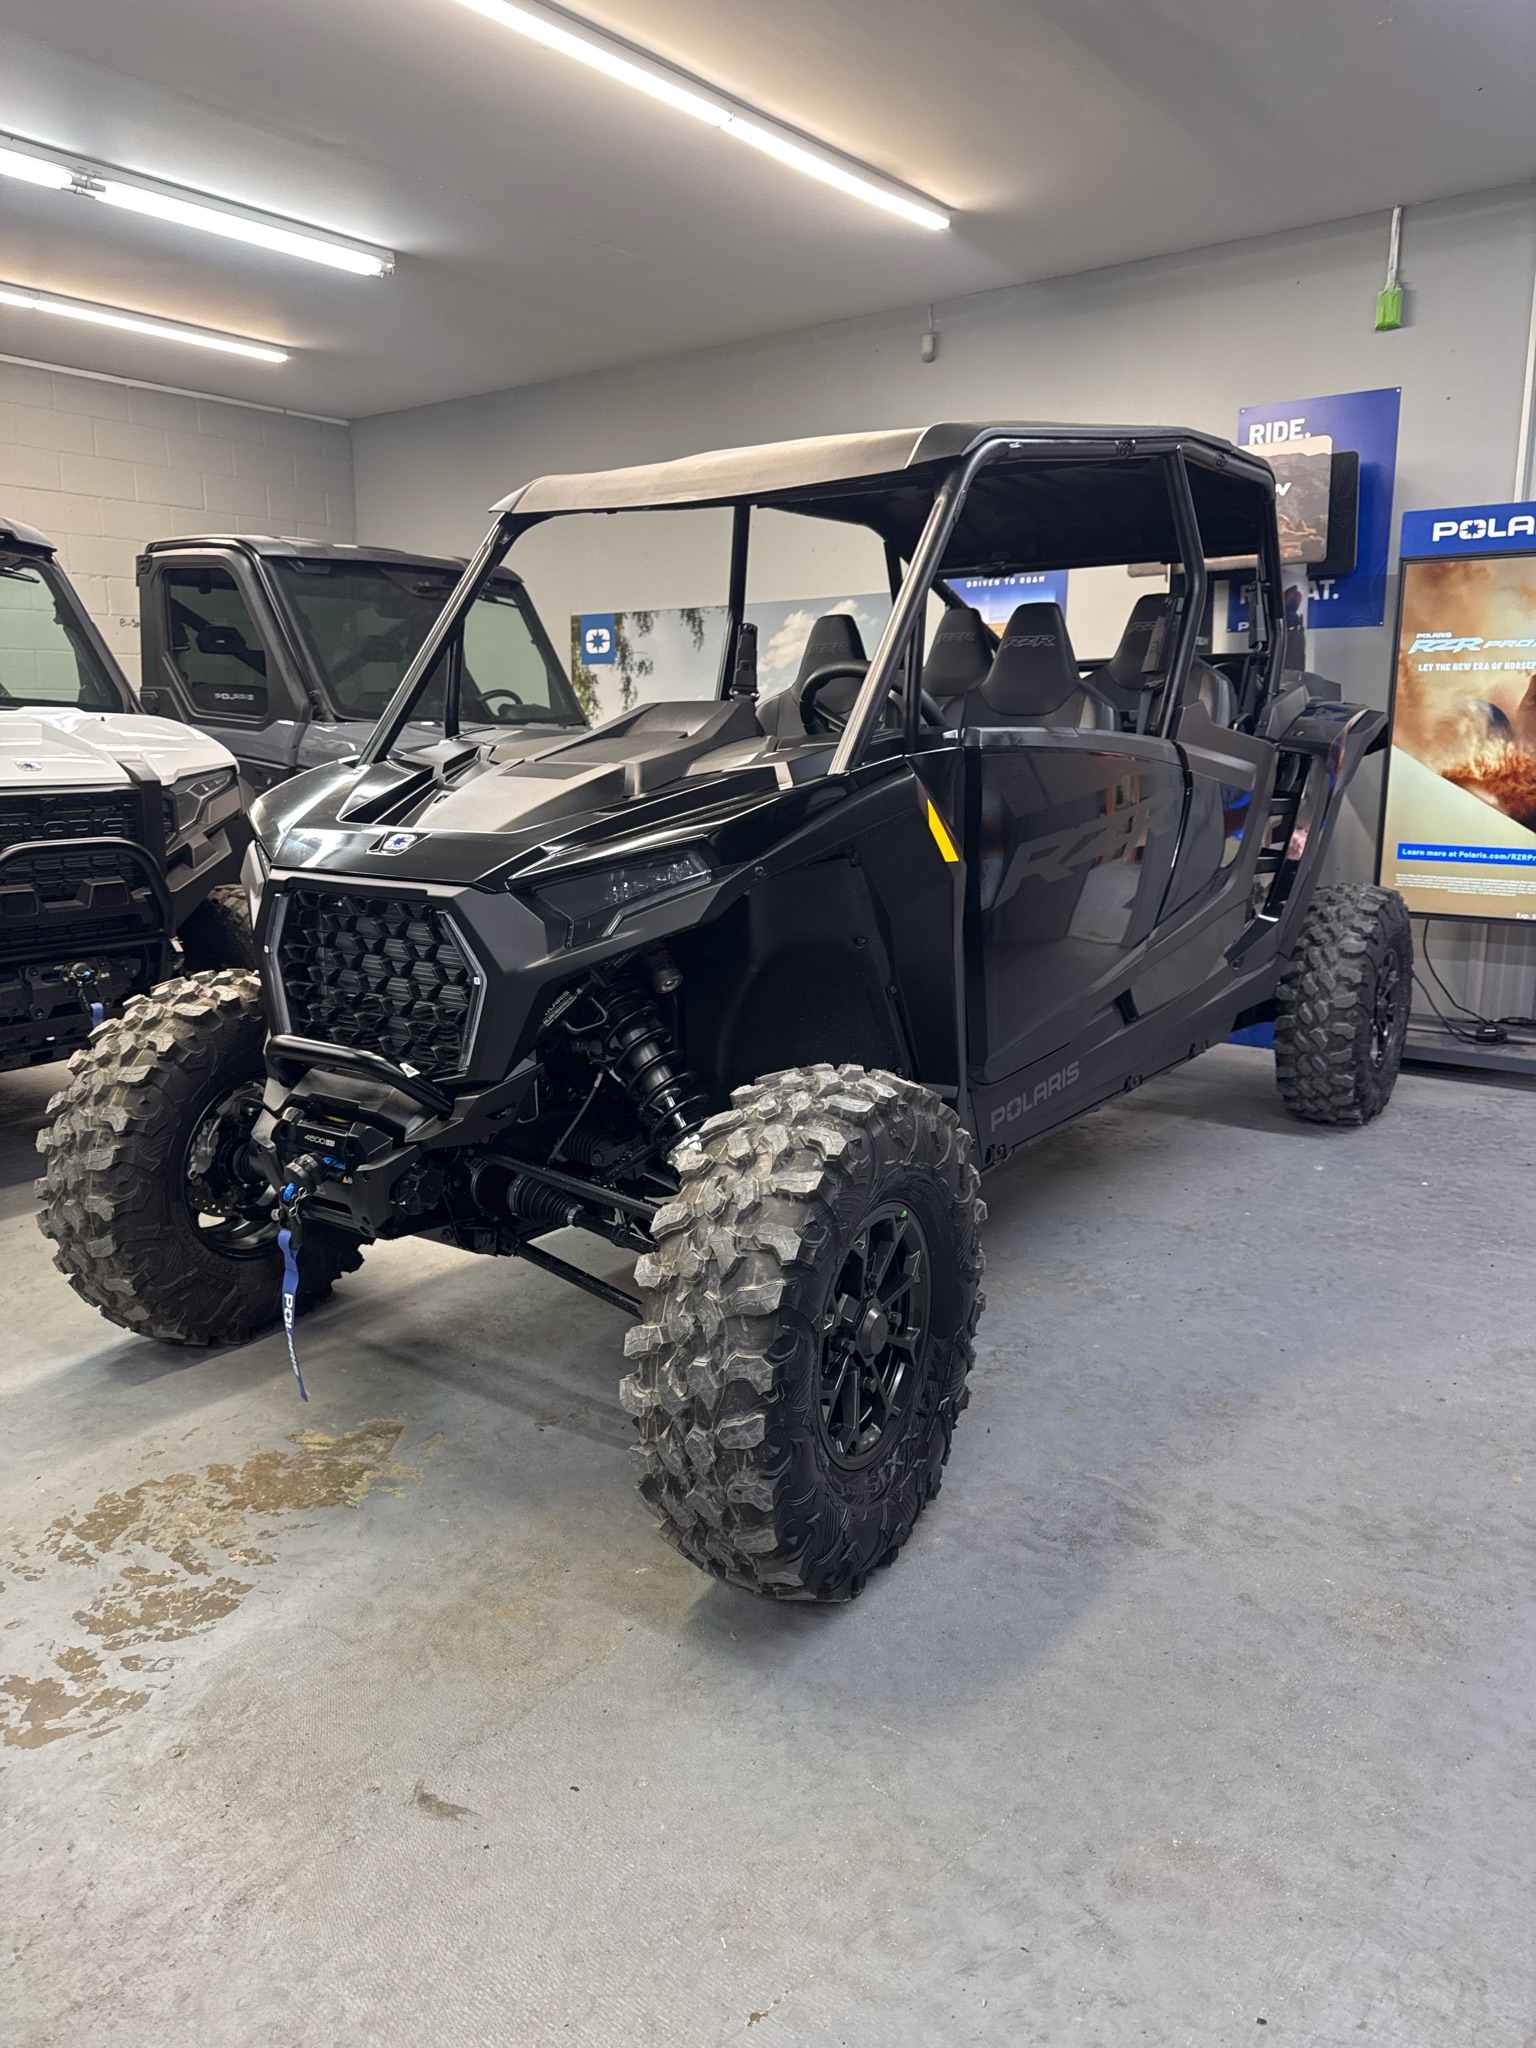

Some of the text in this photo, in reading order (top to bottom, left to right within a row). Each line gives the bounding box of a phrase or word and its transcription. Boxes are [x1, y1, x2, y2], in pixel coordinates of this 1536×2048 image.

[1250, 418, 1311, 445] RIDE.
[1432, 515, 1536, 542] POLA
[966, 575, 1045, 588] DRIVEN TO ROAM
[1003, 635, 1056, 648] RZR
[1408, 637, 1484, 654] RZR
[1418, 663, 1434, 671] LET
[1436, 663, 1451, 671] THE
[1453, 662, 1471, 670] NEW
[1473, 662, 1490, 670] ERA
[1492, 661, 1502, 670] OF
[214, 692, 255, 701] POLARIS
[1402, 848, 1425, 856] Learn
[990, 1060, 1080, 1133] POLARIS
[304, 1134, 326, 1145] 4500
